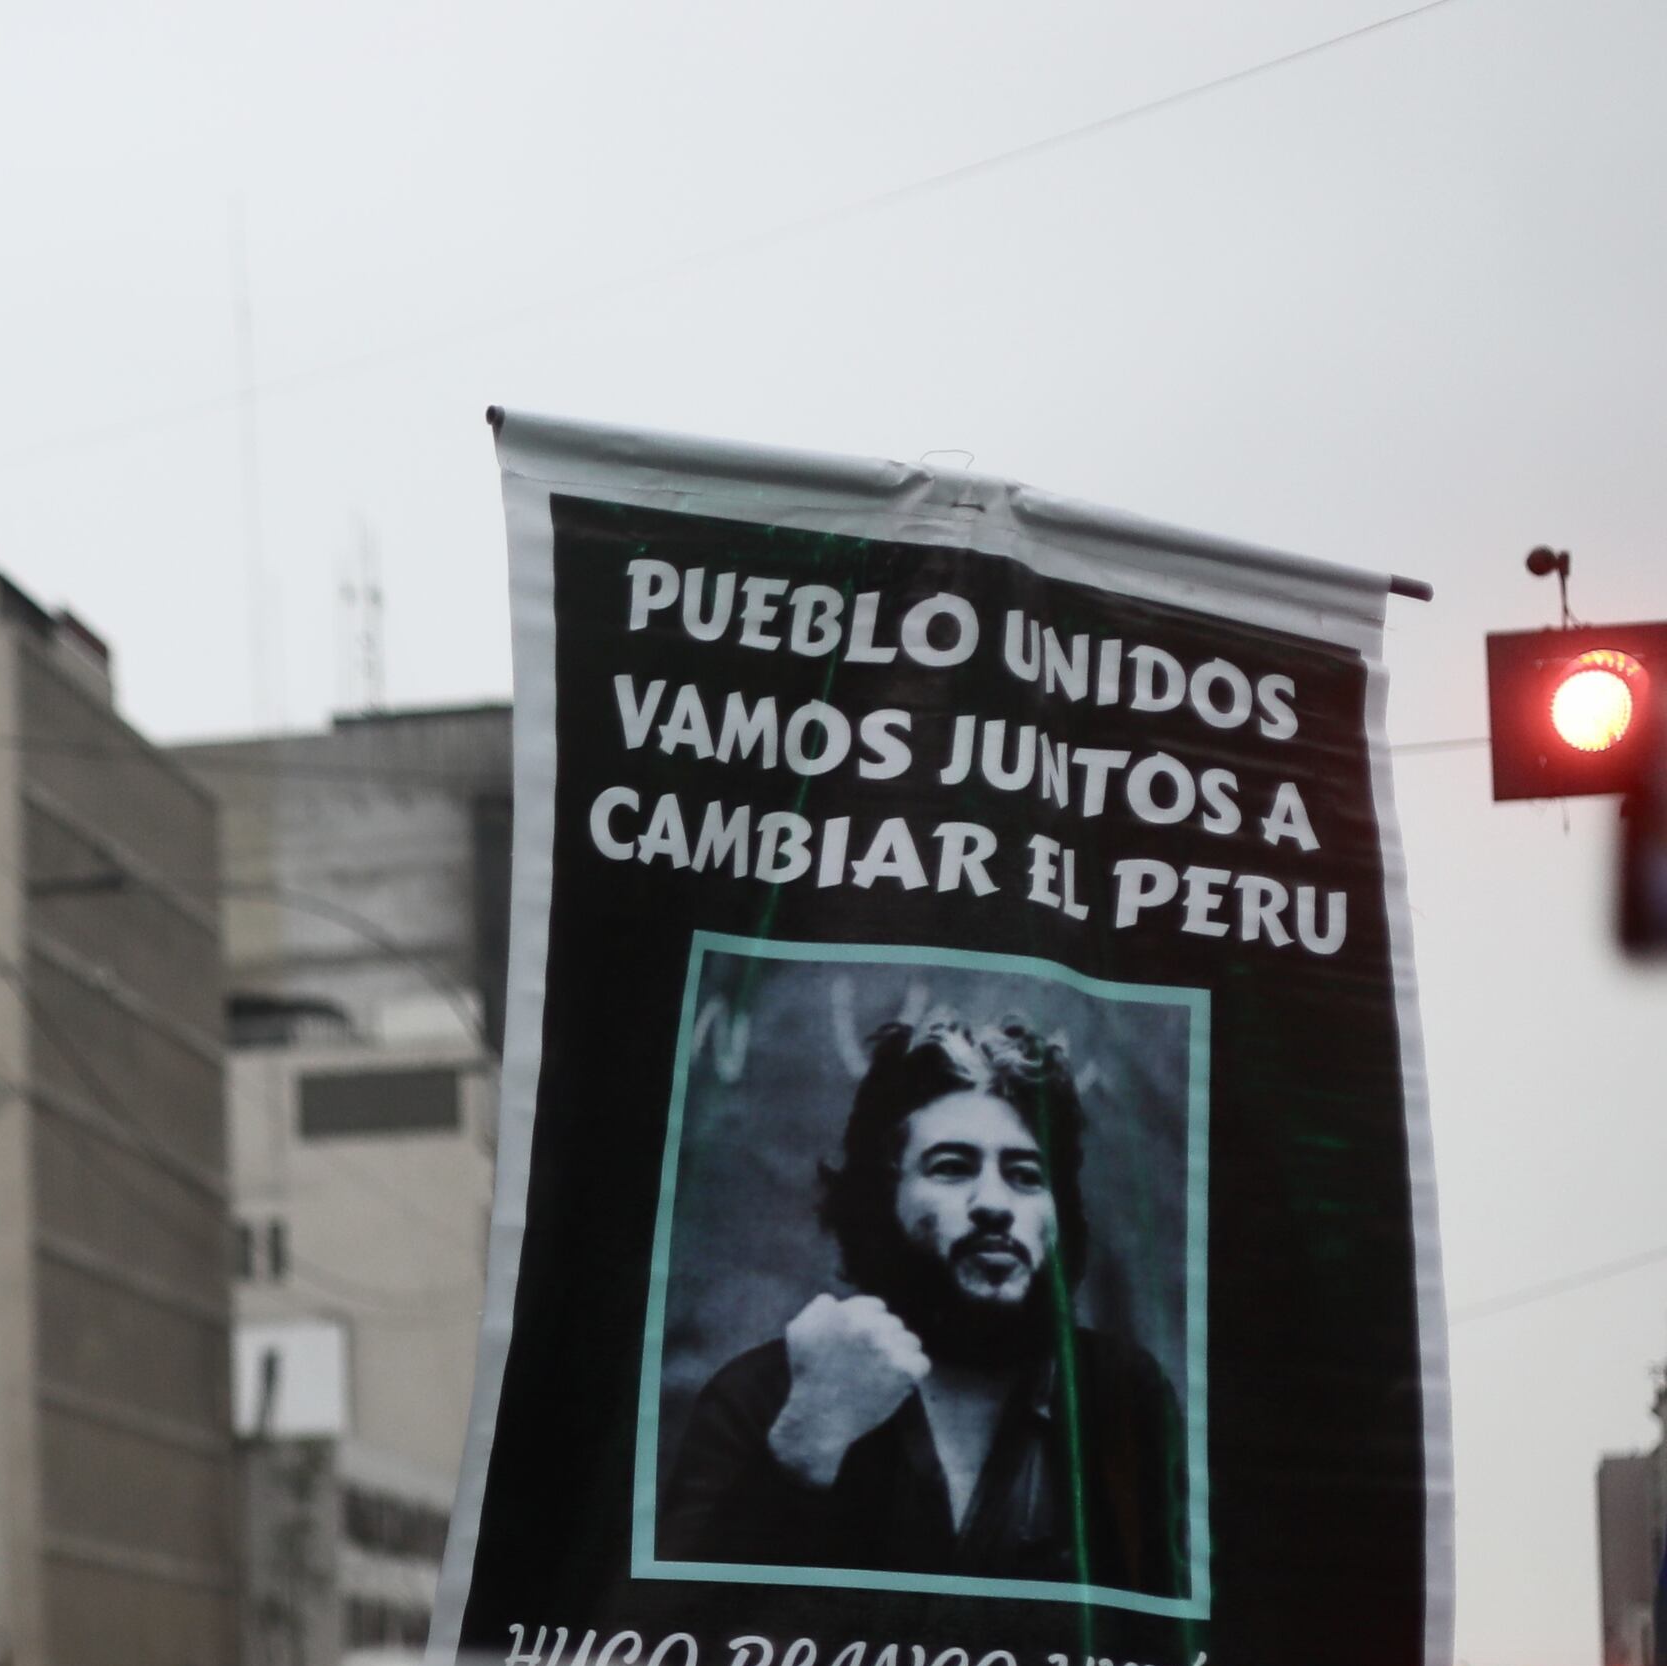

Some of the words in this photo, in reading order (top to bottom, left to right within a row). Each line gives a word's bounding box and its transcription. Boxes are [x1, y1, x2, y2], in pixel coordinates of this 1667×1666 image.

[626, 557, 980, 667] PUEBLO
[1003, 609, 1298, 741] UNIDOS
[614, 674, 912, 780] VAMOS
[940, 714, 1242, 836] JUNTOS
[1262, 782, 1320, 851] A
[588, 785, 1001, 896] CAMBIAR
[1026, 835, 1090, 922] EL
[1114, 857, 1347, 957] PERU
